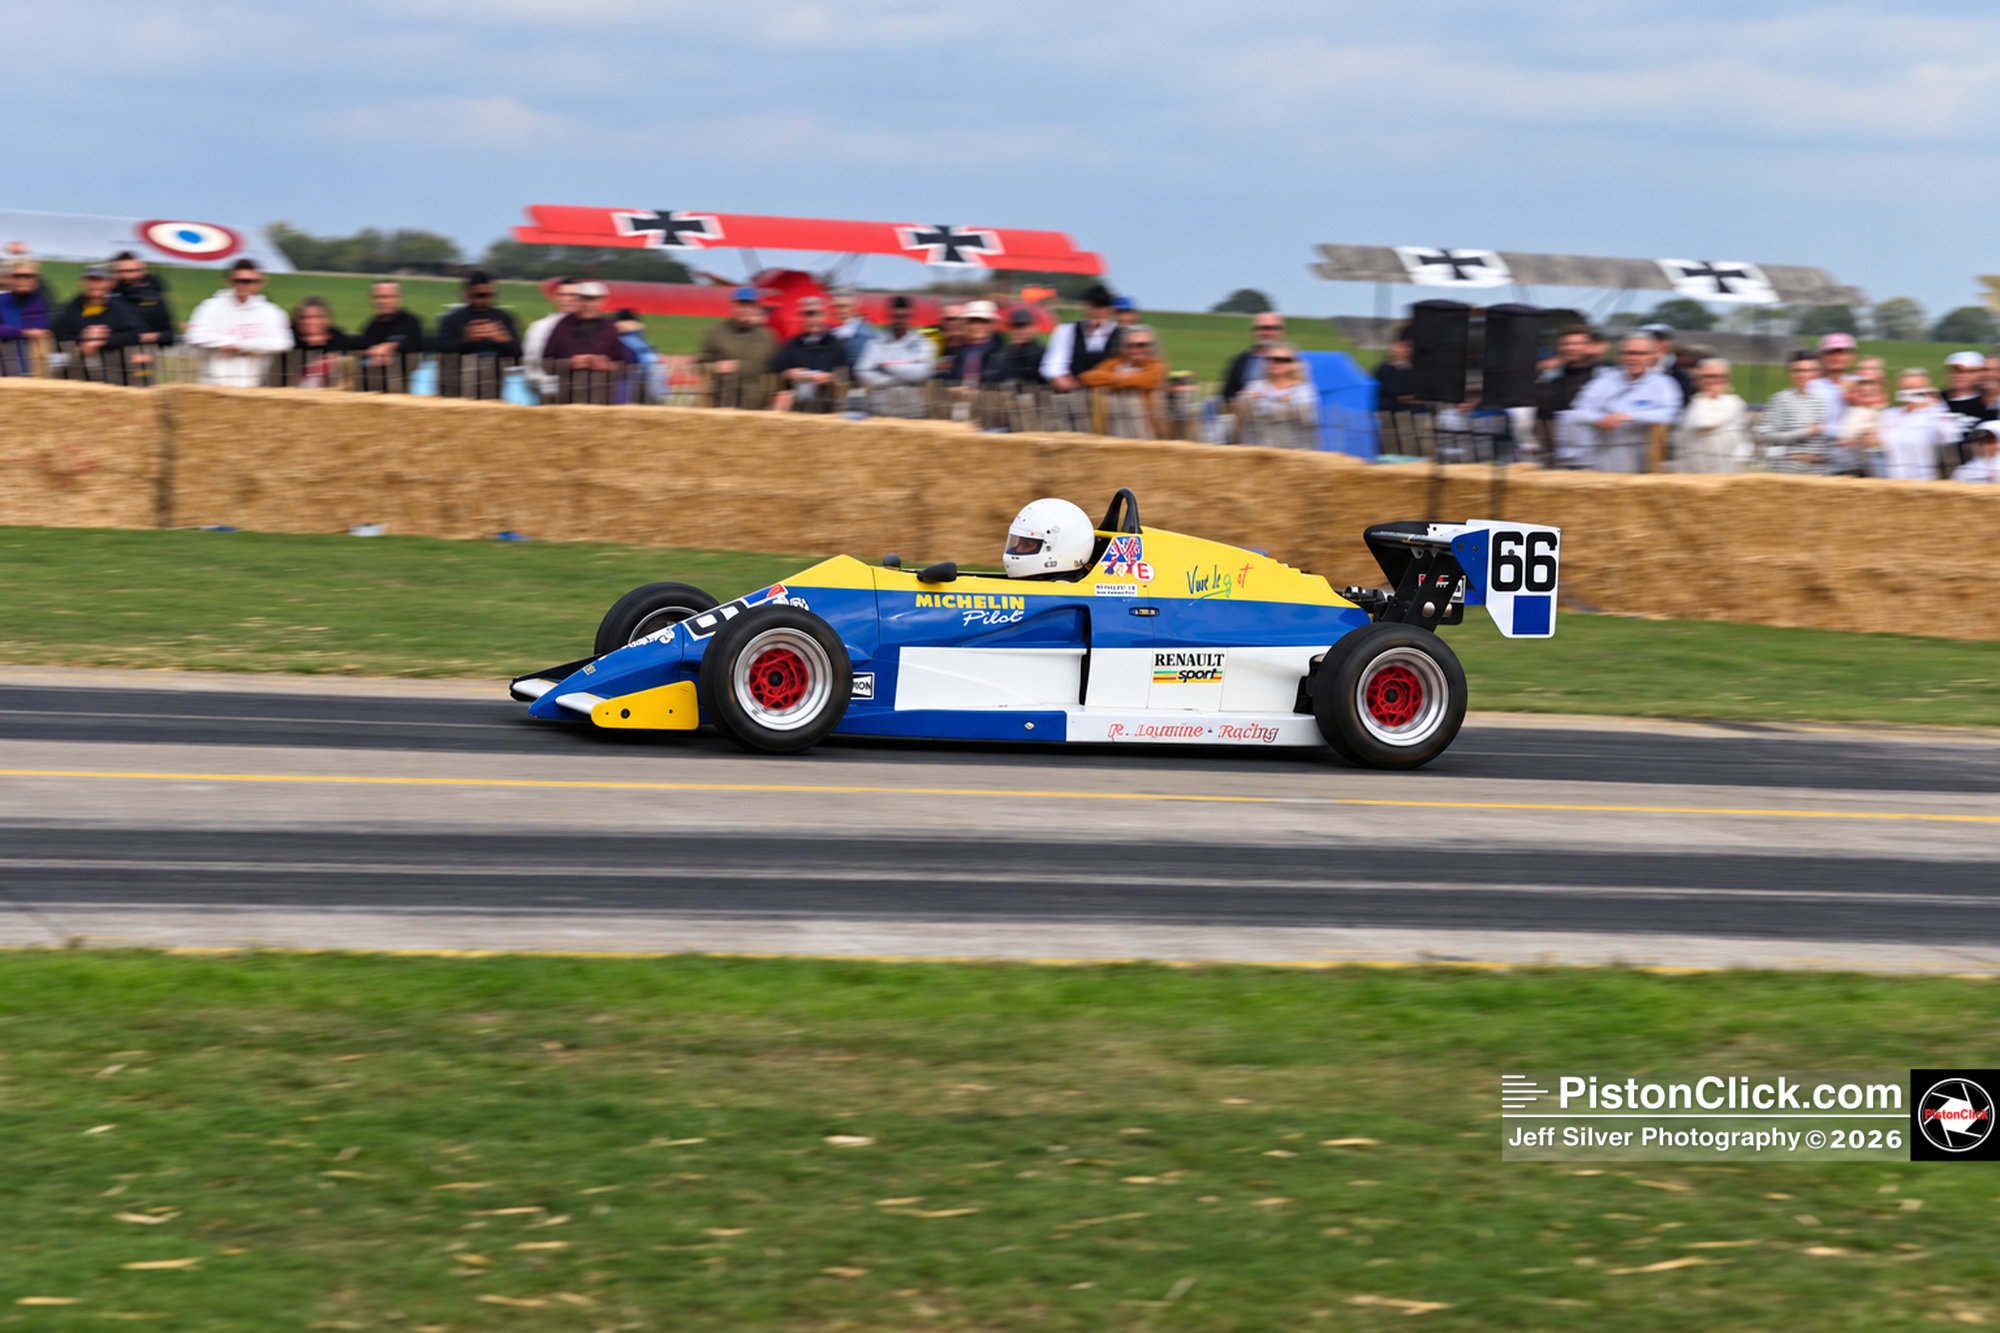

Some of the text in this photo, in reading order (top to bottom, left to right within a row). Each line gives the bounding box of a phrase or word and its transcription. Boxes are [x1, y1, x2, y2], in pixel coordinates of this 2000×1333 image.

[1491, 531, 1558, 592] 66
[1137, 563, 1150, 579] E
[915, 594, 1025, 610] MICHELIN
[962, 610, 1025, 627] Pilot
[1154, 653, 1225, 667] RENAULT
[1178, 668, 1218, 683] sport
[1218, 723, 1279, 743] Racing
